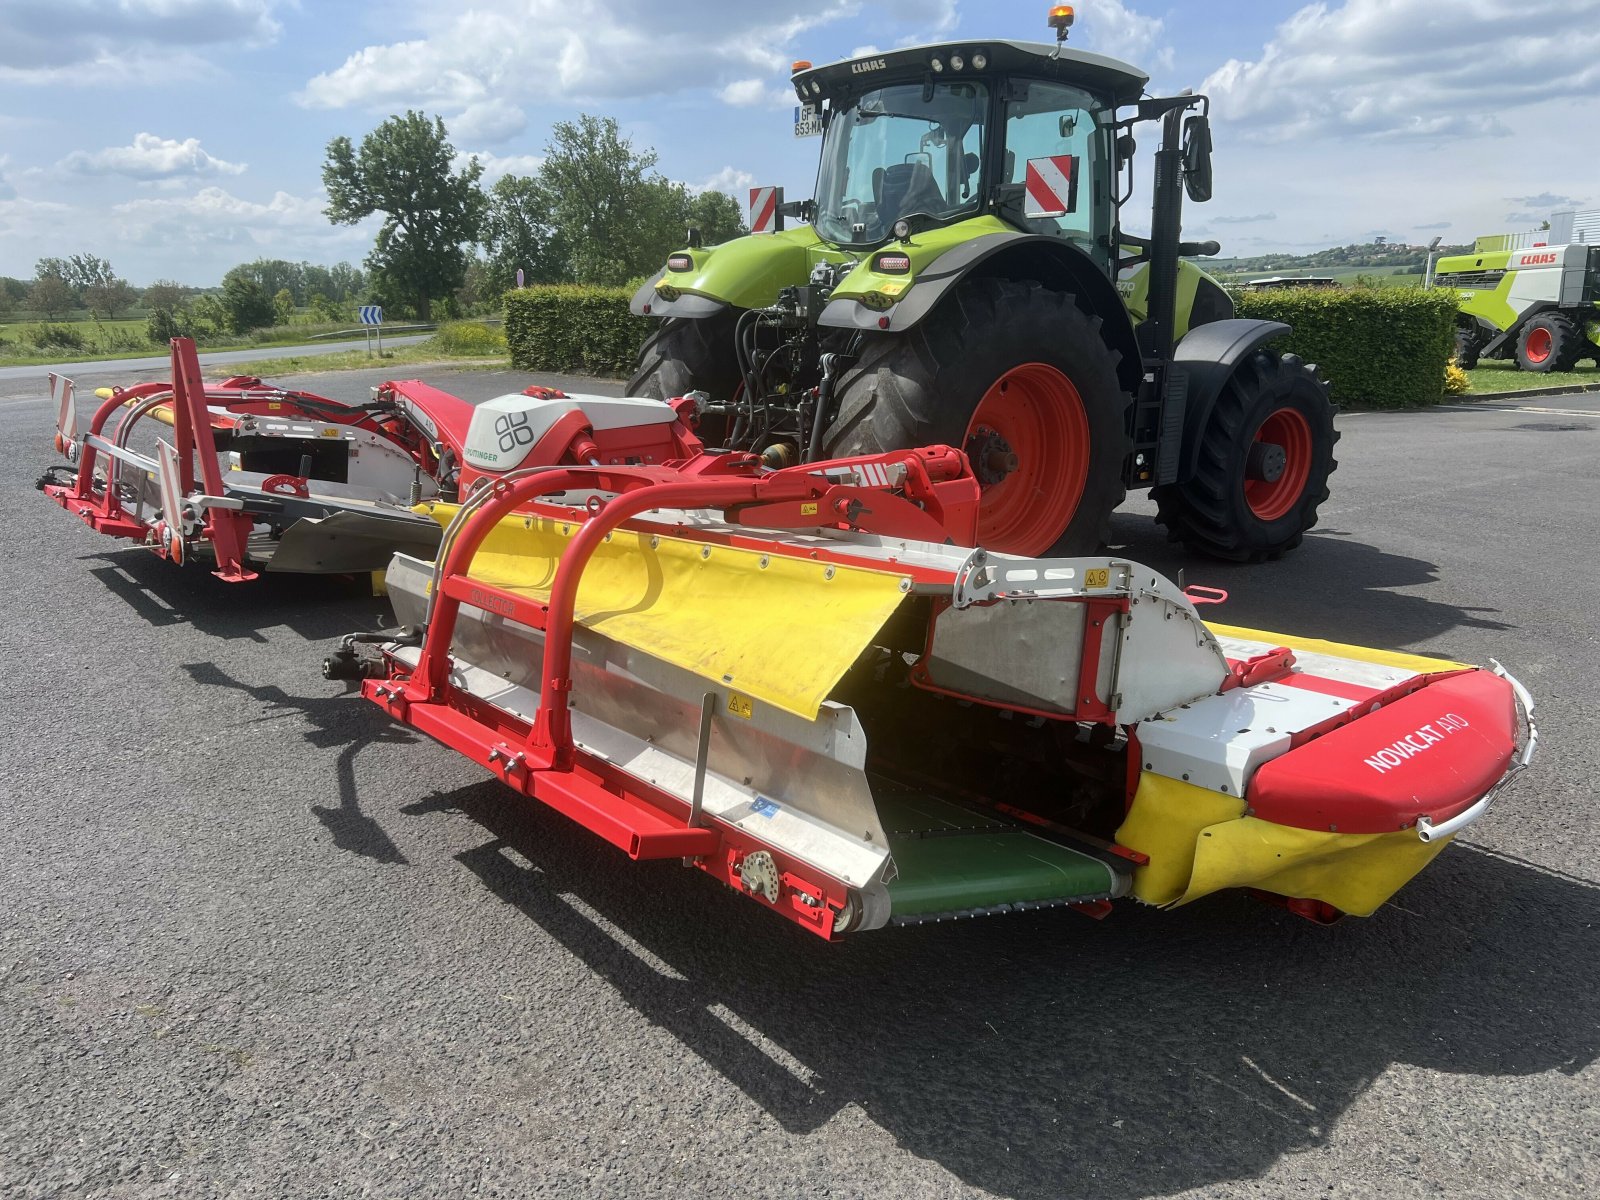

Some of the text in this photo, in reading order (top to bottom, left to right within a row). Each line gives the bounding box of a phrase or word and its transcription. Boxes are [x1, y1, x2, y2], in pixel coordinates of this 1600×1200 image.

[851, 59, 887, 74] CLAAS
[801, 107, 812, 121] GF
[1520, 253, 1556, 265] CLAAS
[471, 589, 515, 615] COLLECTOR
[1363, 713, 1470, 774] NOVACAT A10
